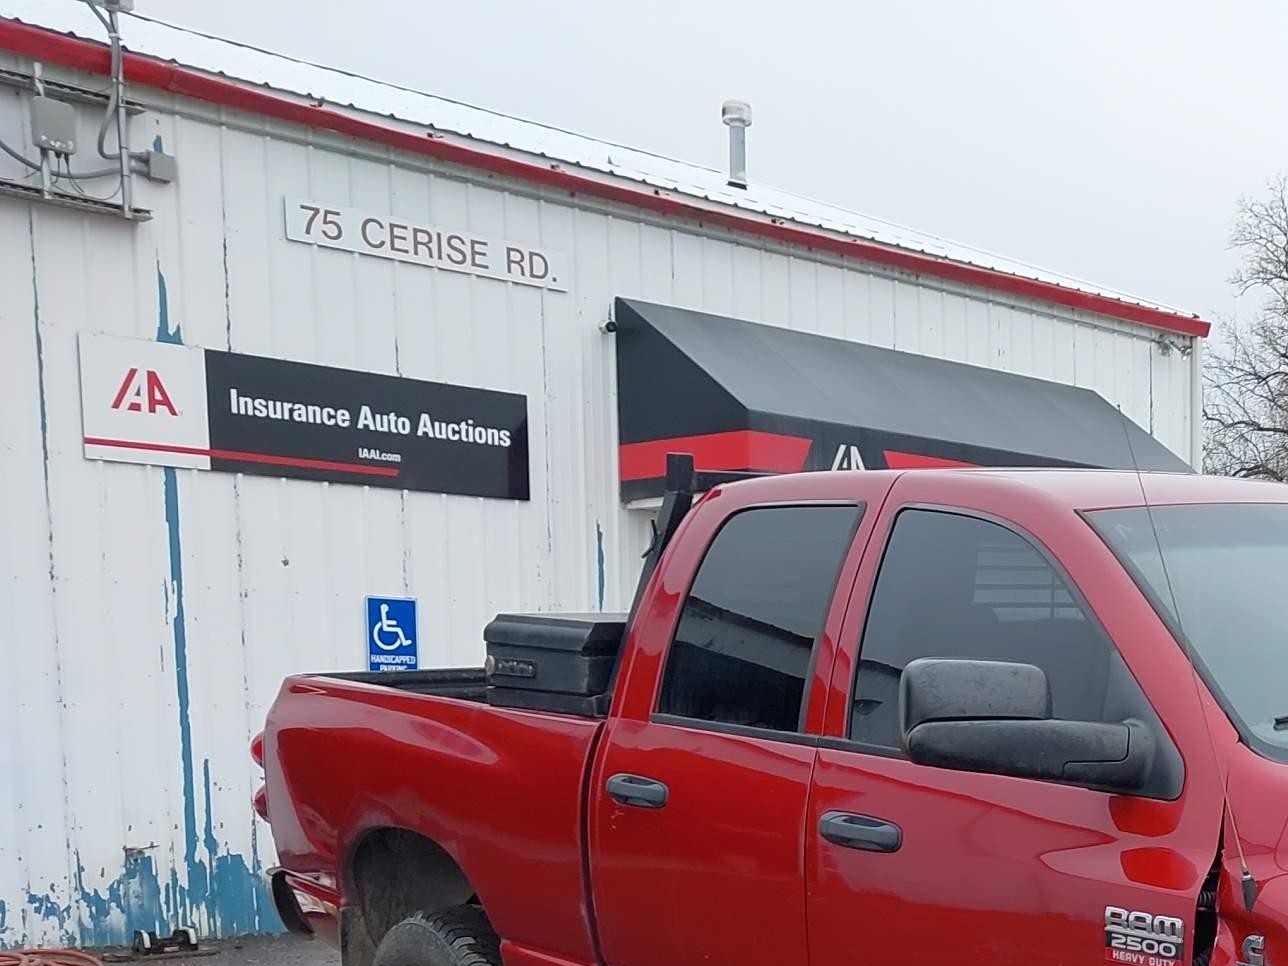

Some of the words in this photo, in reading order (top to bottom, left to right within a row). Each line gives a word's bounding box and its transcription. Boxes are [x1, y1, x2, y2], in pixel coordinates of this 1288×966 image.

[299, 204, 343, 241] 75
[361, 217, 489, 270] CERISE
[506, 246, 558, 283] RD.
[230, 388, 350, 427] Insurance
[357, 405, 410, 435] Auto
[417, 413, 511, 447] Auctions
[358, 447, 401, 462] IAAI.com
[370, 654, 416, 664] HANDICAPPED
[1104, 905, 1183, 938] RAM
[1110, 933, 1177, 957] 2500
[1112, 949, 1146, 964] HEAVY
